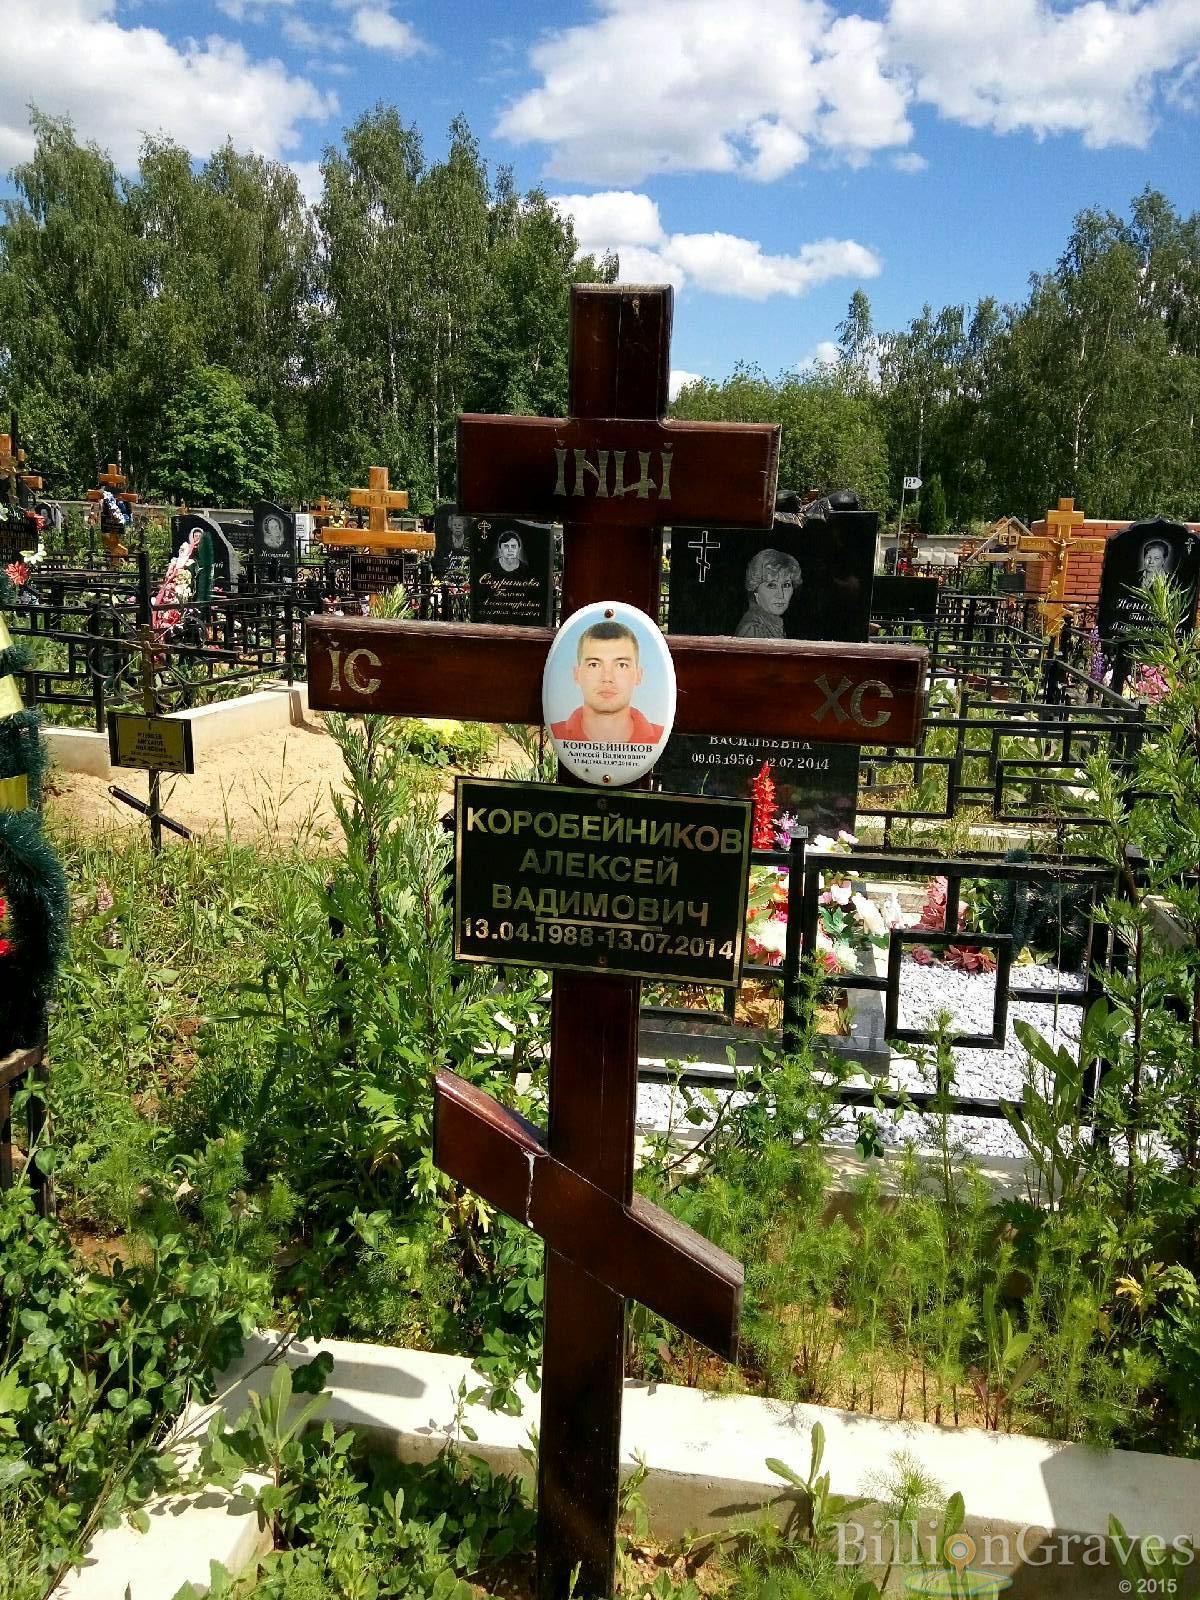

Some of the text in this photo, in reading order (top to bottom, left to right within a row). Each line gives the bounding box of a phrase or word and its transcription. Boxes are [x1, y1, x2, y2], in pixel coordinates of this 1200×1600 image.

[562, 741, 653, 753] КОРОБЕЙНИКОВ
[467, 807, 742, 854] КОРОБЕЙНИКОВ
[519, 849, 678, 886] АЛЕКСЕЙ
[492, 884, 709, 927] ВАДИМОВИЧ
[463, 917, 733, 960] 13.04.1988-13.07.2014
